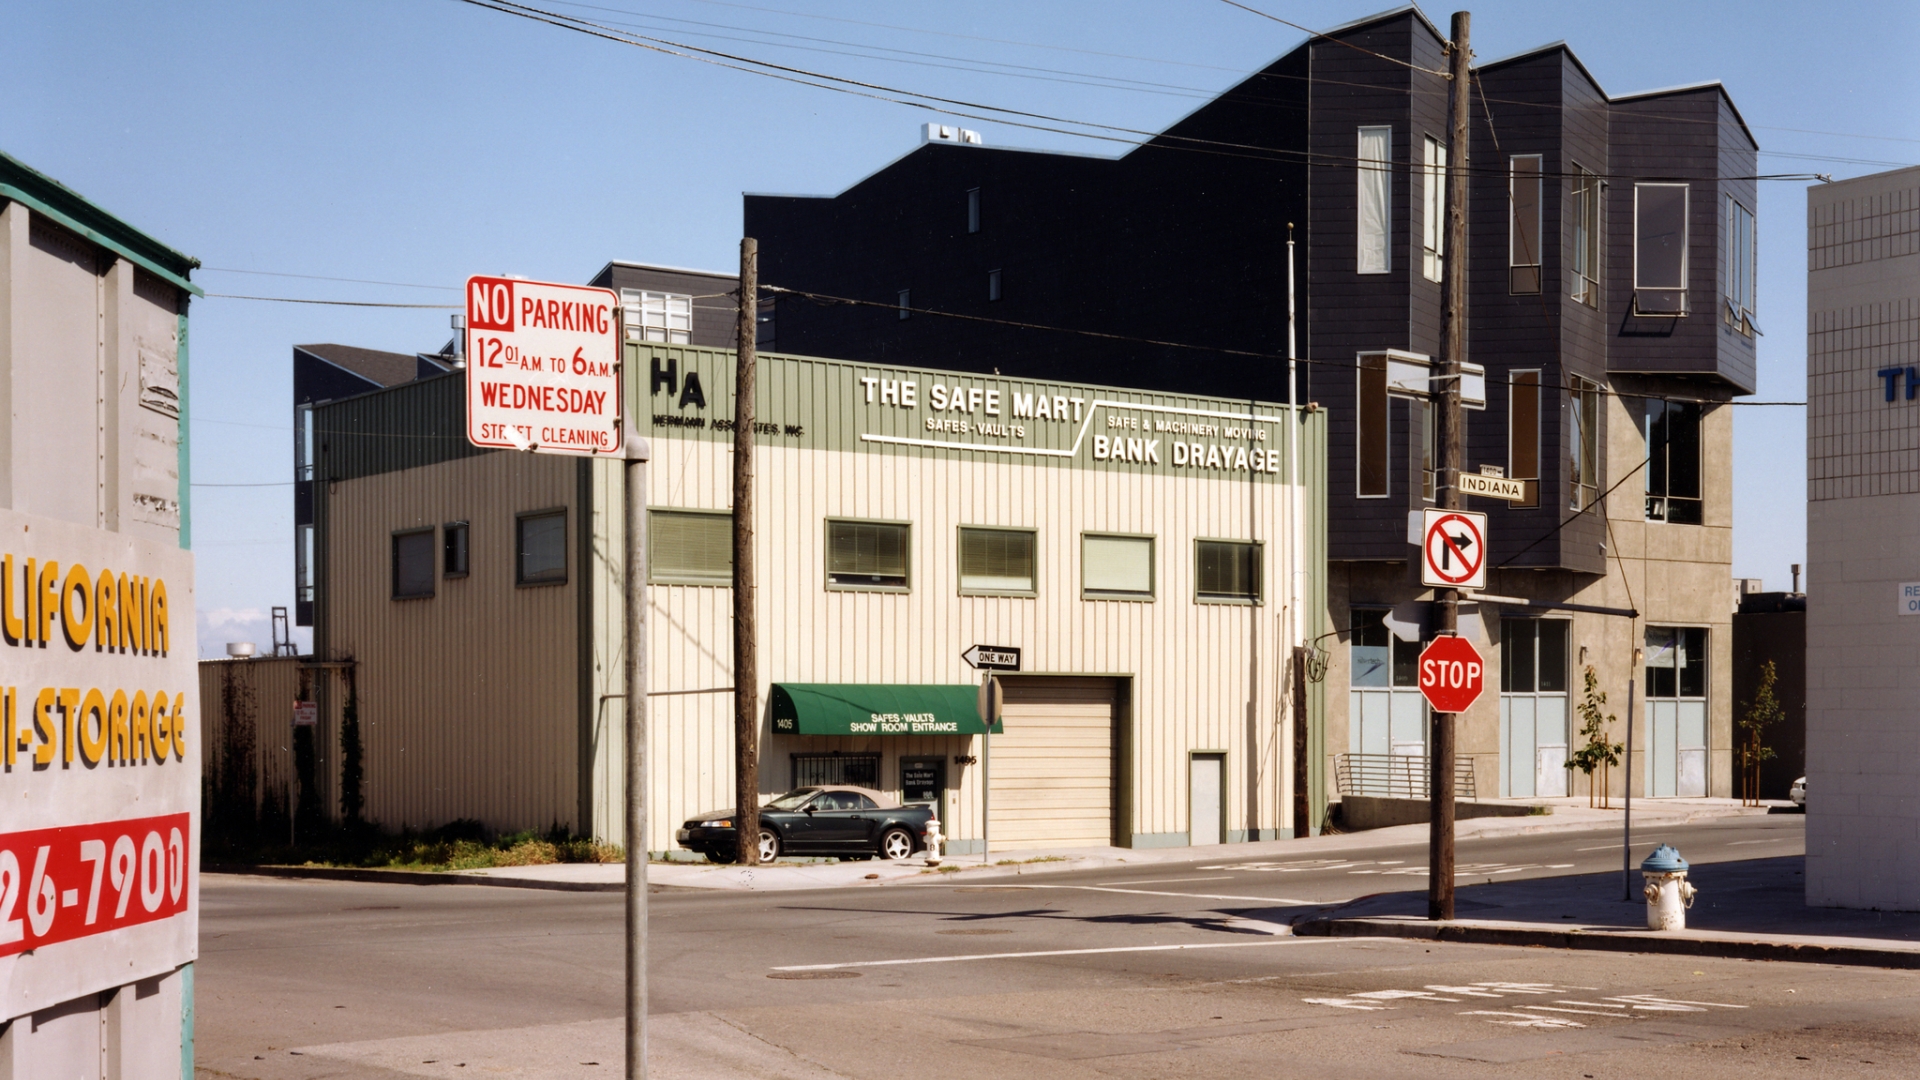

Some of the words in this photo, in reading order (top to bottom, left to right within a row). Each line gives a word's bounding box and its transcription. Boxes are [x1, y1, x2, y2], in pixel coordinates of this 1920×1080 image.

[472, 283, 510, 325] NO
[521, 297, 609, 335] PARKING
[550, 358, 566, 374] TO
[481, 381, 607, 415] WEDNESDAY
[860, 377, 917, 406] THE
[930, 384, 1001, 414] SAFE
[1012, 392, 1085, 421] MART
[542, 427, 608, 446] CLEANING
[1108, 416, 1137, 429] SAFE
[1143, 419, 1150, 430] &
[1155, 420, 1219, 437] MACHINERY
[1224, 427, 1266, 441] MOVING
[1093, 434, 1159, 463] BANK
[1172, 441, 1279, 472] DRAYAGE
[1462, 477, 1520, 496] INDIANA
[979, 653, 995, 663] ONE
[998, 653, 1015, 664] WAY
[1422, 658, 1481, 689] STOP
[0, 685, 185, 773] I-STORAGE
[777, 718, 793, 730] 1405
[850, 722, 877, 732] SHOW
[881, 722, 908, 732] ROOM
[912, 722, 958, 732] ENTRANCE
